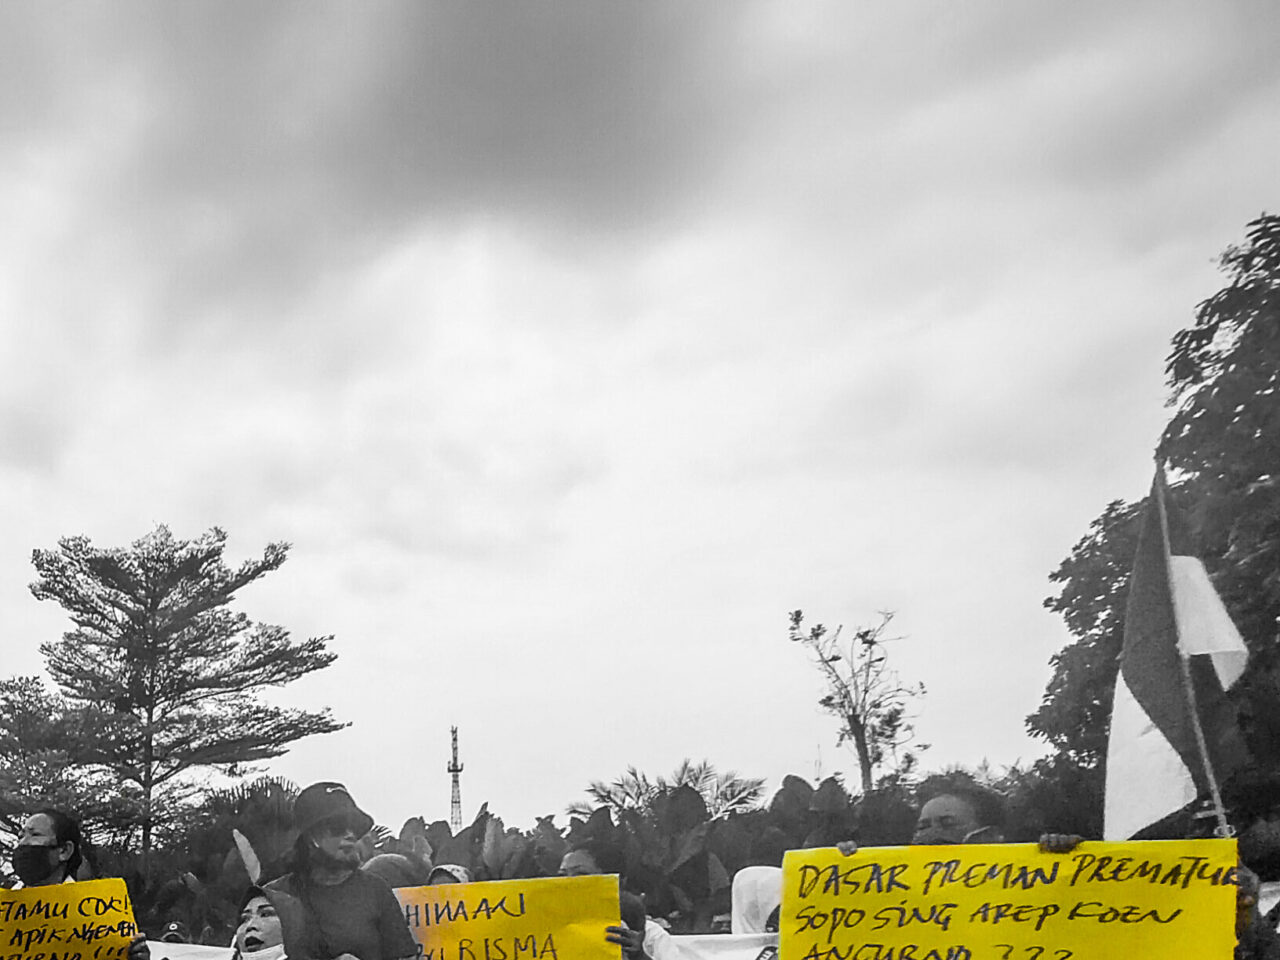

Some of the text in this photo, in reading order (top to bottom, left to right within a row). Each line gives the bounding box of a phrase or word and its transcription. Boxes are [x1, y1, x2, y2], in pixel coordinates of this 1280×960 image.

[798, 862, 911, 899] DASAR
[923, 859, 1059, 896] PREMAN
[9, 924, 66, 953] APIK
[795, 905, 866, 944] SOPO
[871, 900, 959, 931] SING
[969, 903, 1060, 931] AREP
